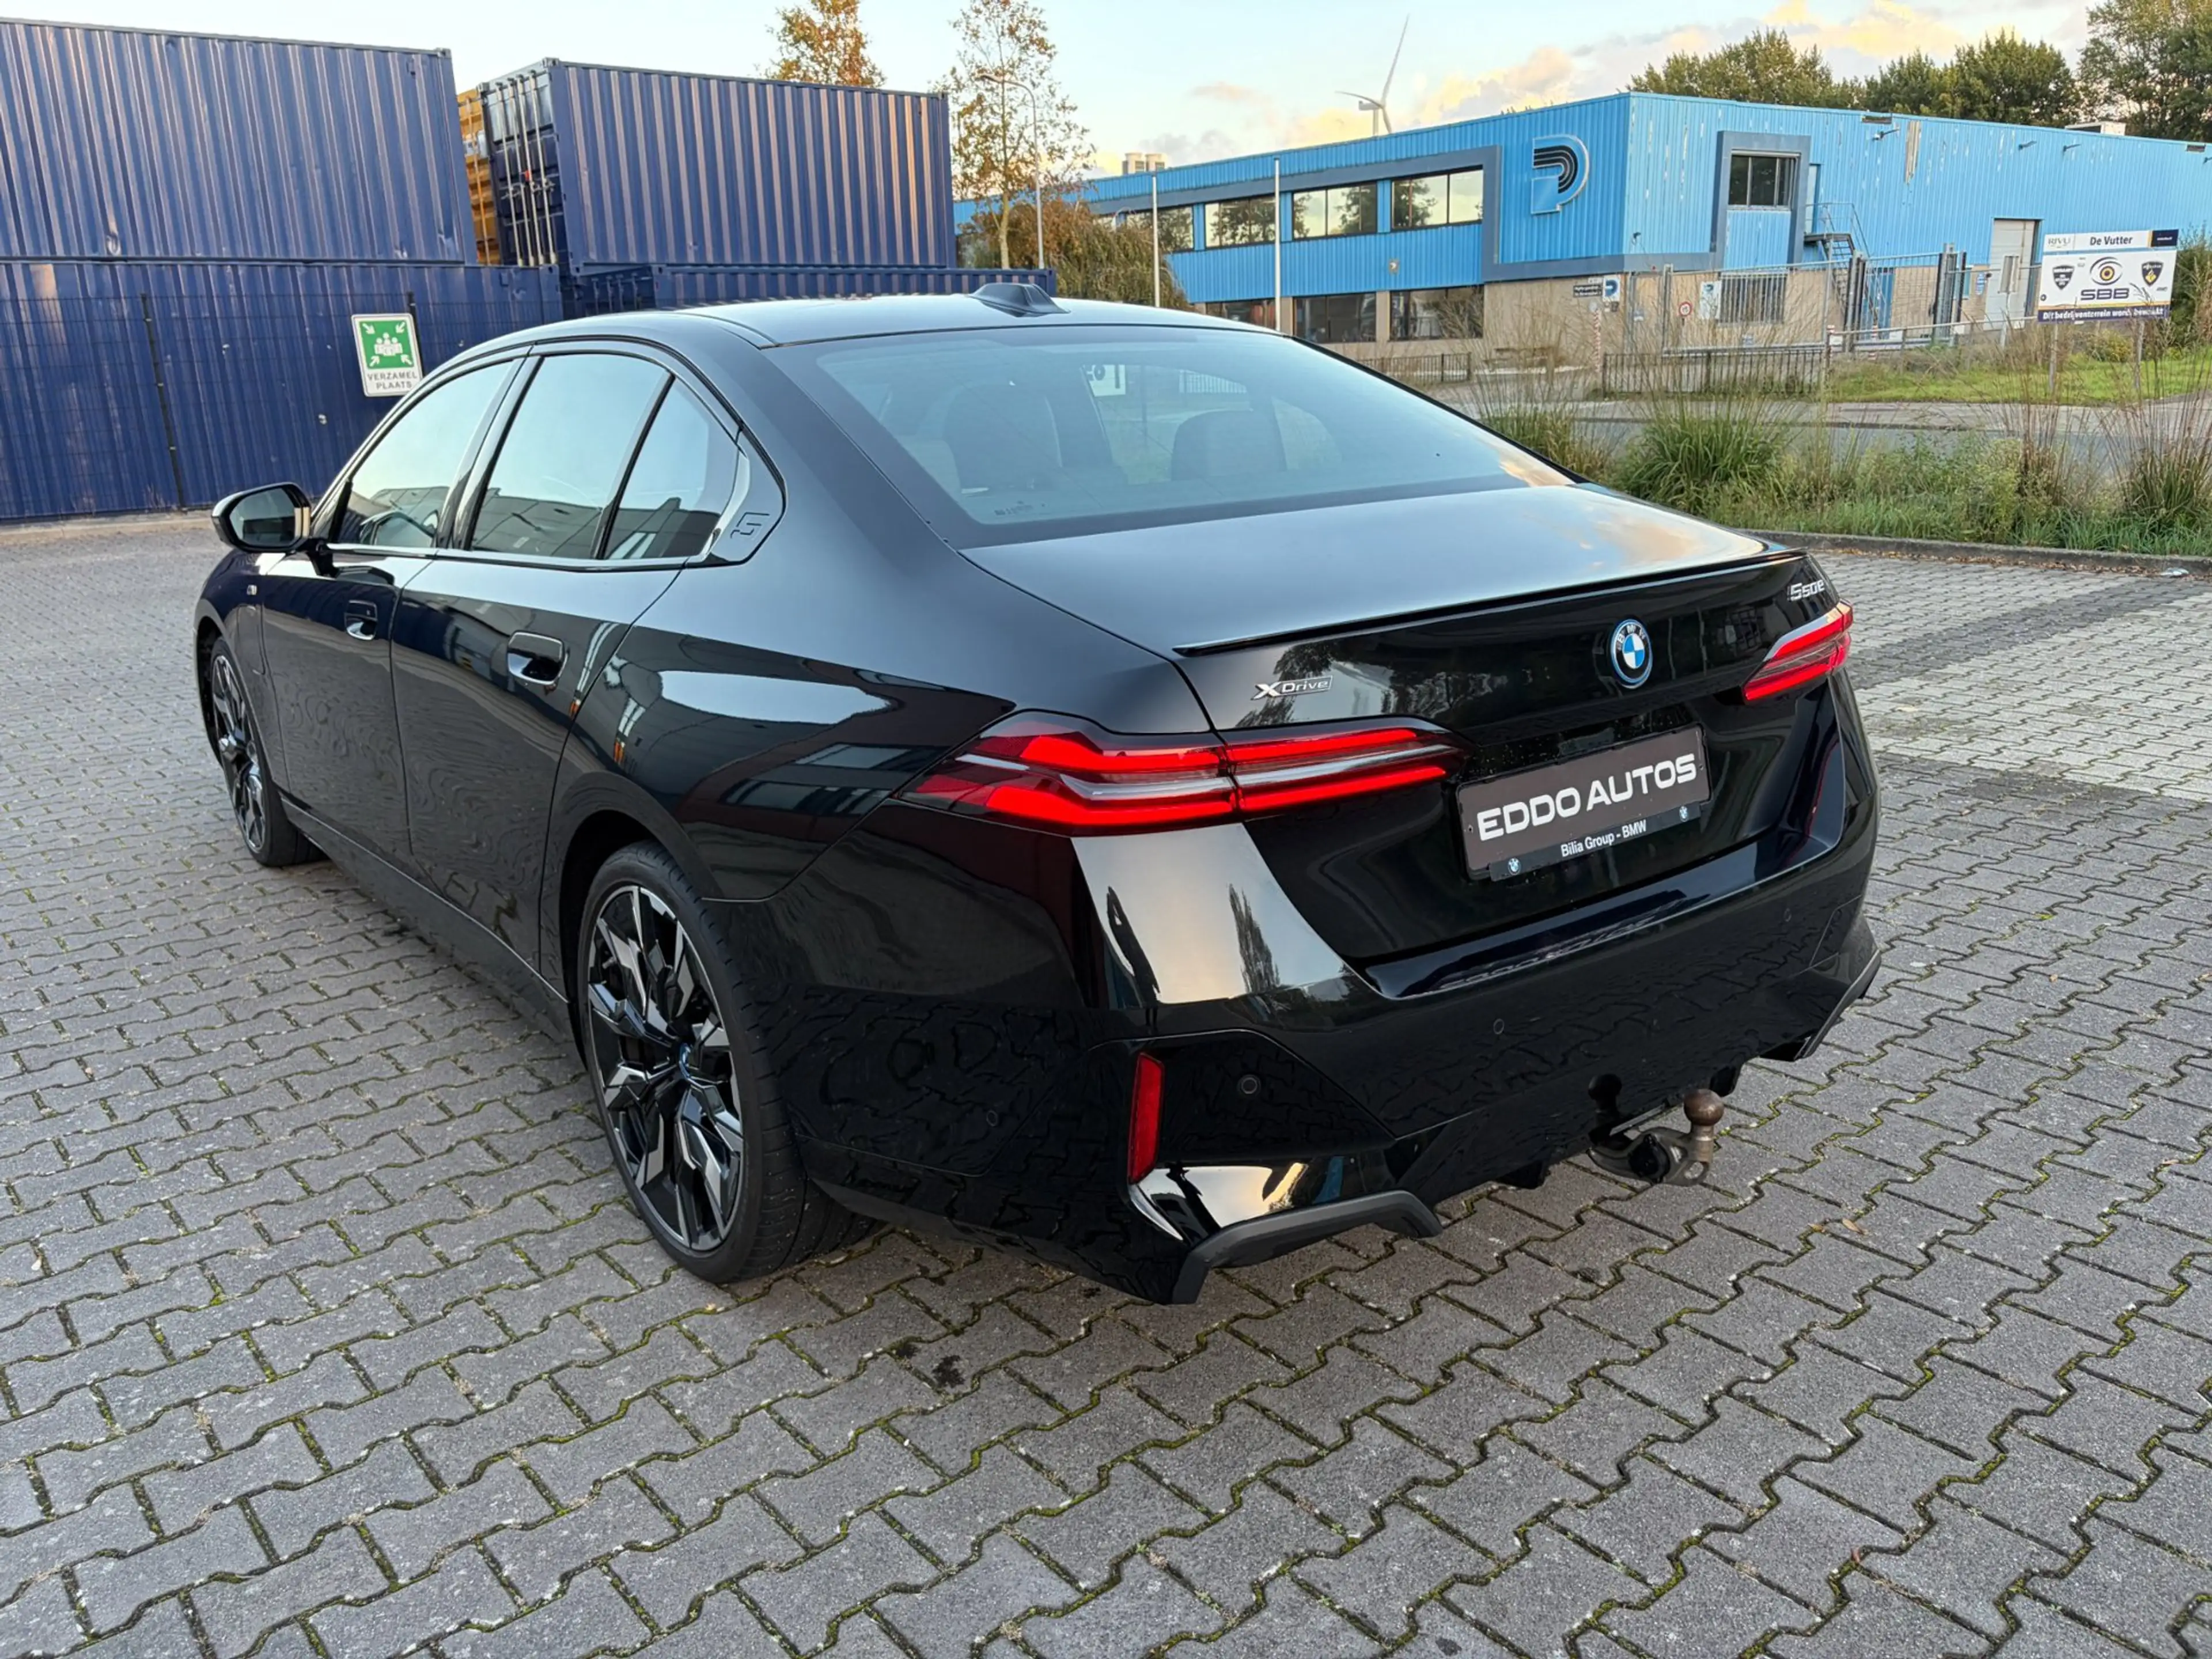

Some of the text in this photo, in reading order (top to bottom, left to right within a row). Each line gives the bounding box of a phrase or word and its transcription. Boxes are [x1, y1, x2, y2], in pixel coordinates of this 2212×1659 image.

[2090, 236, 2133, 245] De Vutter
[2080, 288, 2130, 301] SBB
[368, 372, 418, 381] VERZAMEL
[376, 381, 412, 389] PLAATS
[1476, 753, 1698, 841] EDDO AUTOS
[1560, 841, 1584, 857] Bilia
[1585, 832, 1615, 850] Group
[1622, 819, 1647, 838] BMW
